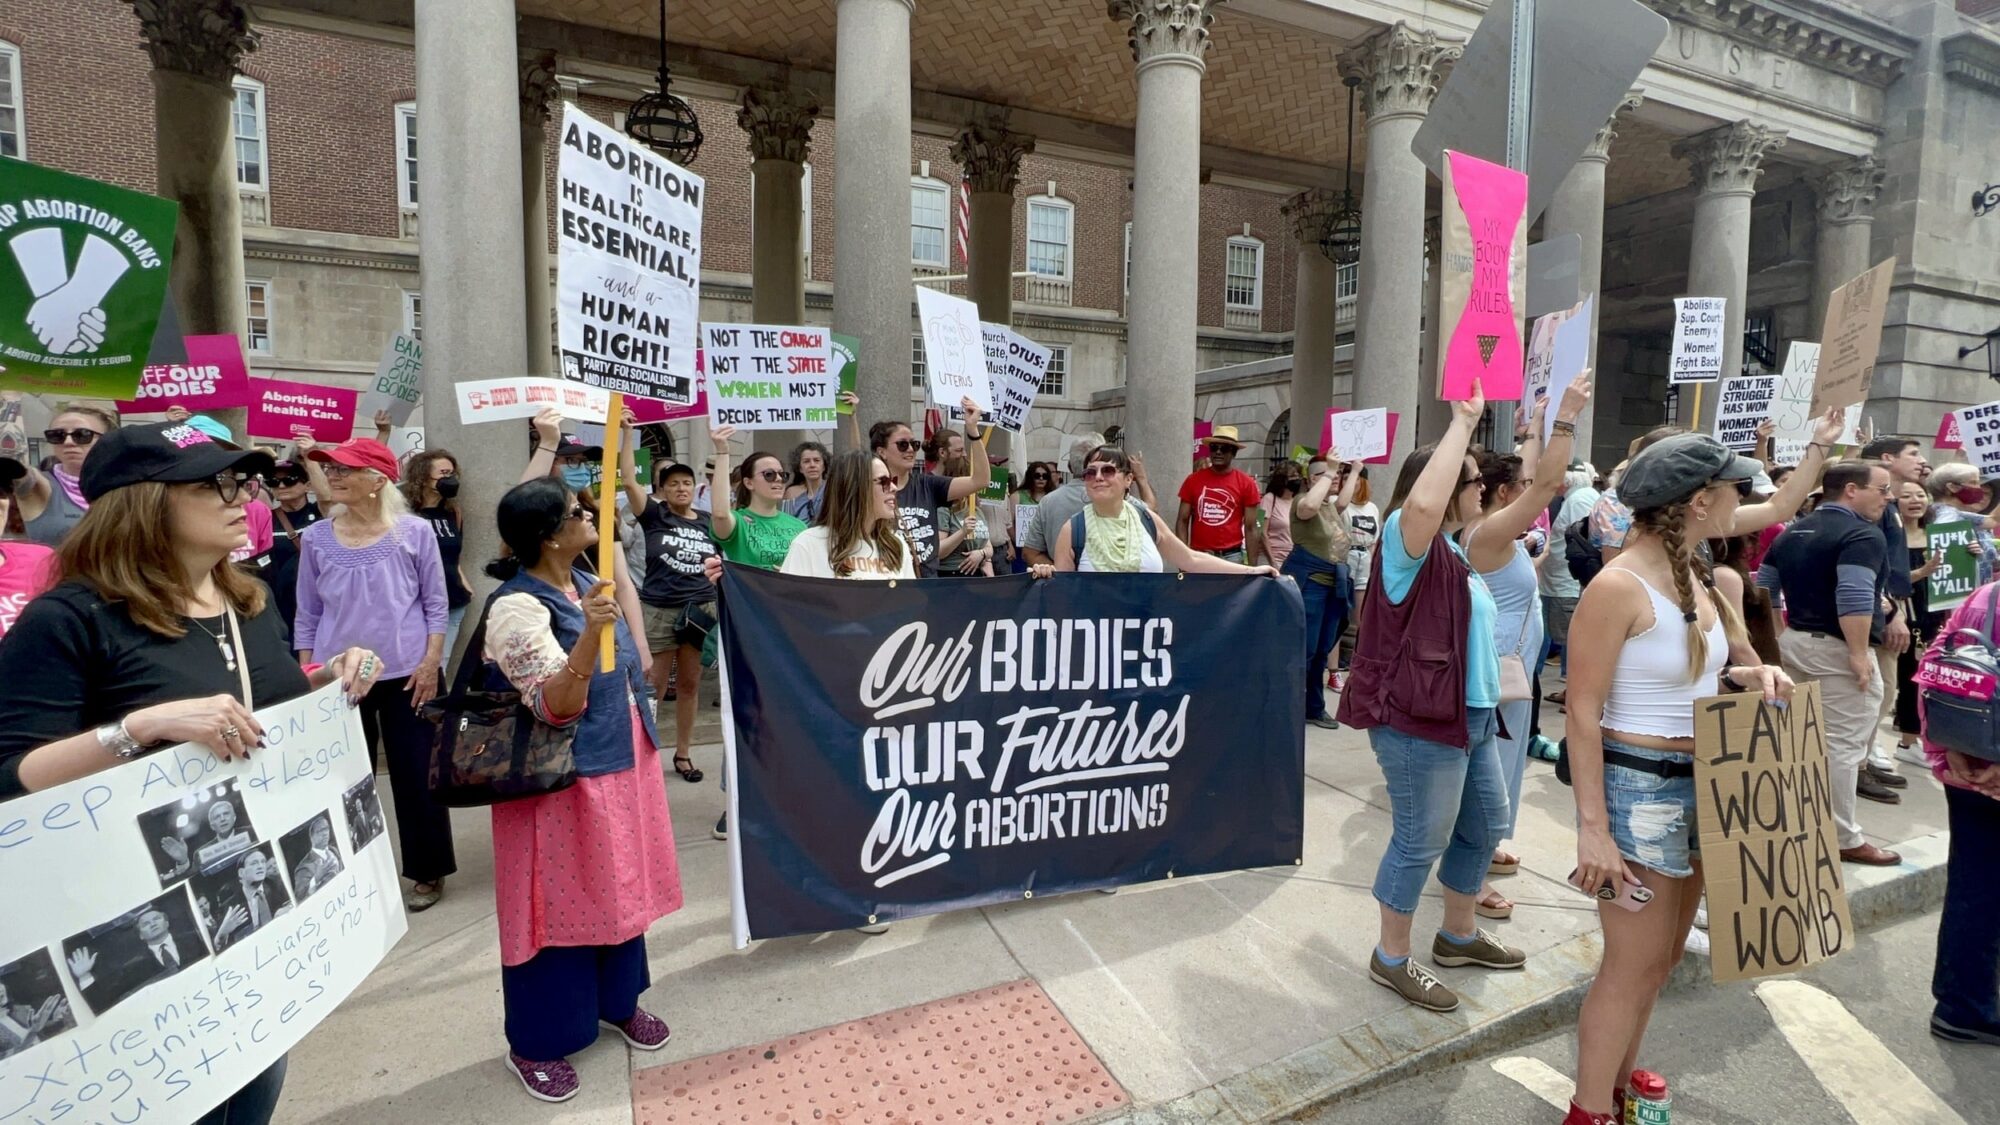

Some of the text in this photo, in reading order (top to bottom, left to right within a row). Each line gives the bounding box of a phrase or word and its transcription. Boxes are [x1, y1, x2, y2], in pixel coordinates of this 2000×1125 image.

[1678, 26, 1789, 90] USE
[563, 121, 700, 208] ABORTION
[630, 183, 643, 207] IS
[562, 178, 697, 255] HEALTHCARE,
[0, 199, 162, 270] OP ABORTION BANS
[1483, 218, 1501, 240] MY
[562, 208, 696, 288] ESSENTIAL,
[1482, 267, 1501, 288] MY
[1470, 288, 1509, 315] RULES
[1683, 300, 1712, 310] Abolish
[581, 291, 670, 338] HUMAN
[710, 329, 741, 347] NOT
[749, 330, 779, 348] THE
[981, 330, 1008, 345] hurch,
[1683, 326, 1711, 338] Enemy
[5, 346, 42, 363] ABORTO
[42, 355, 89, 367] ACCESIBLE
[92, 358, 98, 366] Y
[99, 354, 132, 366] SEGURO
[394, 335, 423, 359] BAN
[583, 324, 670, 370] RIGHT!
[1009, 342, 1045, 369] OTUS:
[394, 356, 423, 373] OFF
[583, 357, 611, 375] PARTY
[630, 368, 677, 388] SOCIALISM
[712, 356, 740, 374] NOT
[751, 356, 783, 374] THE
[787, 356, 826, 374] STATE
[1676, 357, 1698, 370] Fight
[140, 365, 222, 384] FF OUR
[388, 367, 418, 385] OUR
[583, 372, 600, 387] AND
[938, 370, 973, 388] UTERUS
[1008, 364, 1041, 388] RTION
[1728, 378, 1774, 391] ONLY THE
[135, 380, 217, 399] BODIES
[376, 377, 420, 403] BODIES
[715, 380, 827, 398] WOMEN MUST
[1006, 387, 1031, 406] MAN
[1723, 389, 1774, 402] STRUGGLE
[1781, 376, 1813, 399] NO
[262, 390, 338, 408] Abortion is
[1723, 401, 1769, 414] HAS WON
[262, 403, 344, 421] Health Care.
[717, 408, 763, 425] DECIDE
[767, 407, 802, 422] THEIR
[1003, 401, 1022, 420] HT!
[1964, 405, 2000, 421] DEFE
[1976, 419, 2000, 433] RO
[1974, 435, 1993, 447] BY
[661, 535, 715, 554] FUTURES
[676, 550, 702, 563] OUR
[1931, 577, 1973, 596] Y'ALL
[860, 617, 1174, 708] Our BODIES
[1920, 670, 1937, 681] GO
[1940, 666, 1985, 684] WON'T
[1706, 691, 1823, 766] I AM A
[863, 694, 1191, 793] OUR Futures
[282, 724, 350, 786] Legal
[0, 694, 350, 848] eep AboON SA
[1710, 756, 1832, 839] WOMAN
[861, 783, 1170, 876] Our ABORTIONS
[1739, 828, 1839, 905] NOT A
[255, 917, 321, 970] Liars,
[323, 875, 358, 920] and
[1734, 888, 1843, 972] WOMB
[28, 884, 377, 1125] isogynists are not
[95, 961, 331, 1125] ustices"
